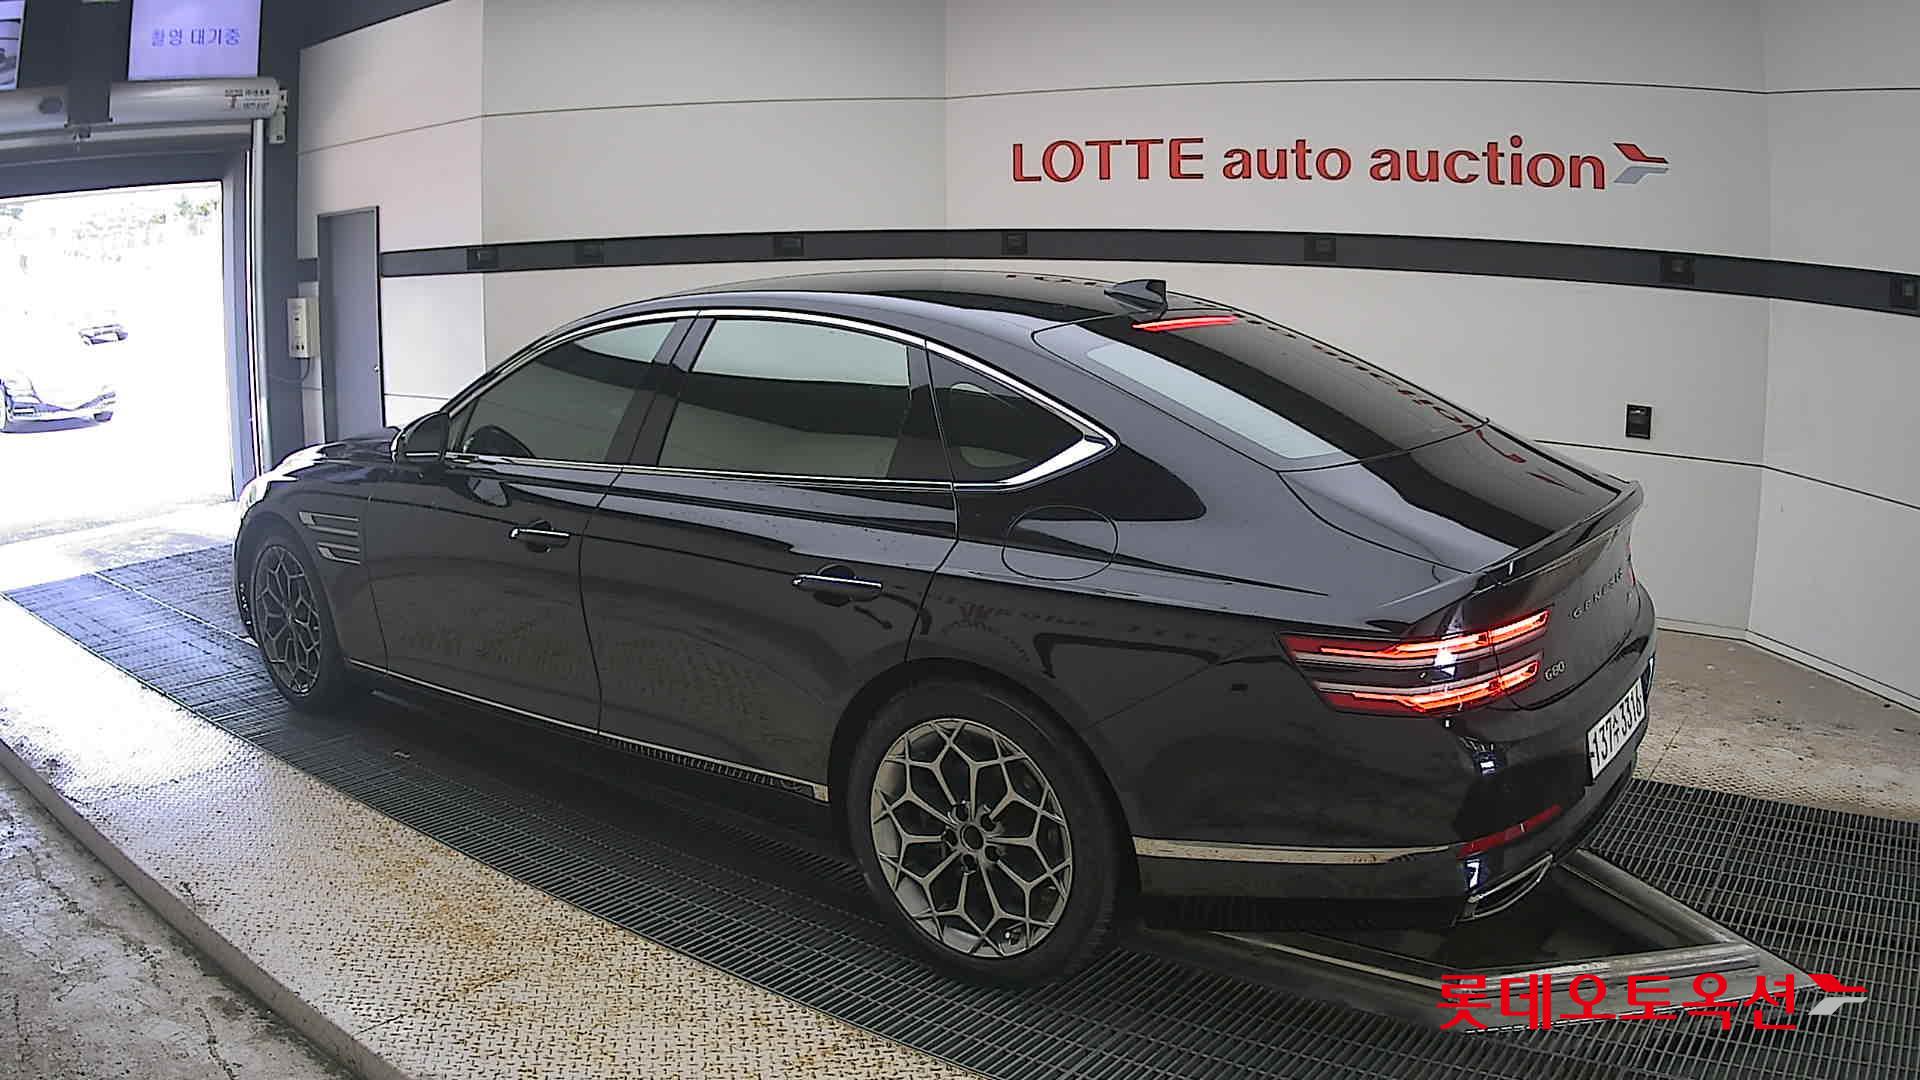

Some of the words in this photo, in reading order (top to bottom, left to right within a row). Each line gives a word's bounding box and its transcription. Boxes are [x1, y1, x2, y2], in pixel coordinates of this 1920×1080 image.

[191, 28, 240, 46] 대기중
[1013, 138, 1204, 182] LOTTE
[1222, 139, 1353, 181] auto
[1370, 136, 1607, 191] auction
[1545, 660, 1566, 681] G80
